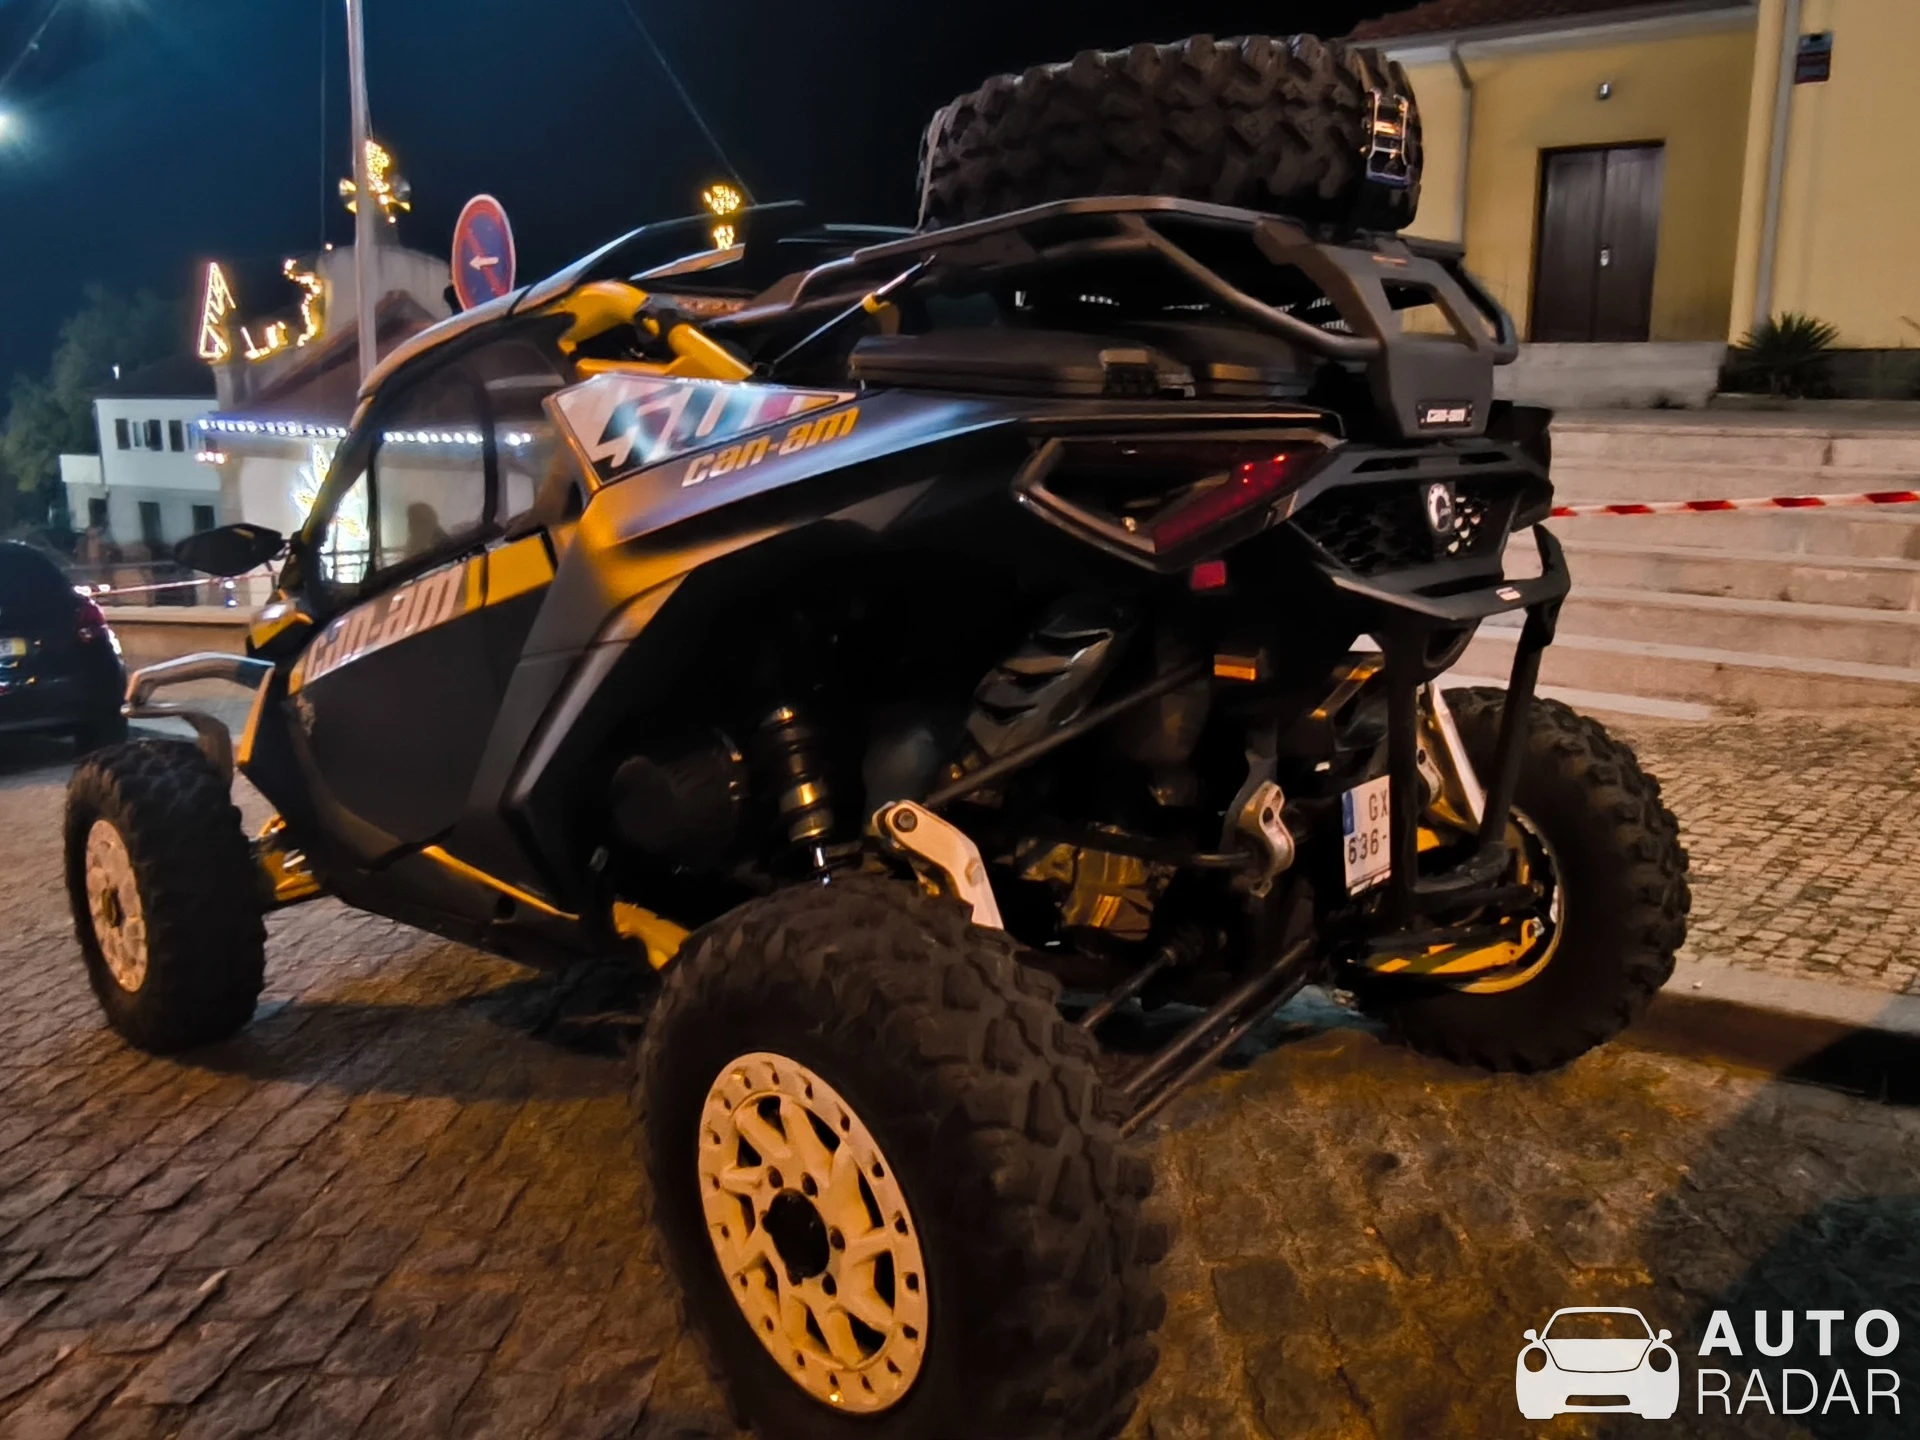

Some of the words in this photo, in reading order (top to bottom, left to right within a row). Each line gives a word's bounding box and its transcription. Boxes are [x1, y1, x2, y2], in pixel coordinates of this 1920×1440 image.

[682, 406, 860, 487] can-am
[303, 563, 466, 685] can-am
[1368, 789, 1389, 821] GX
